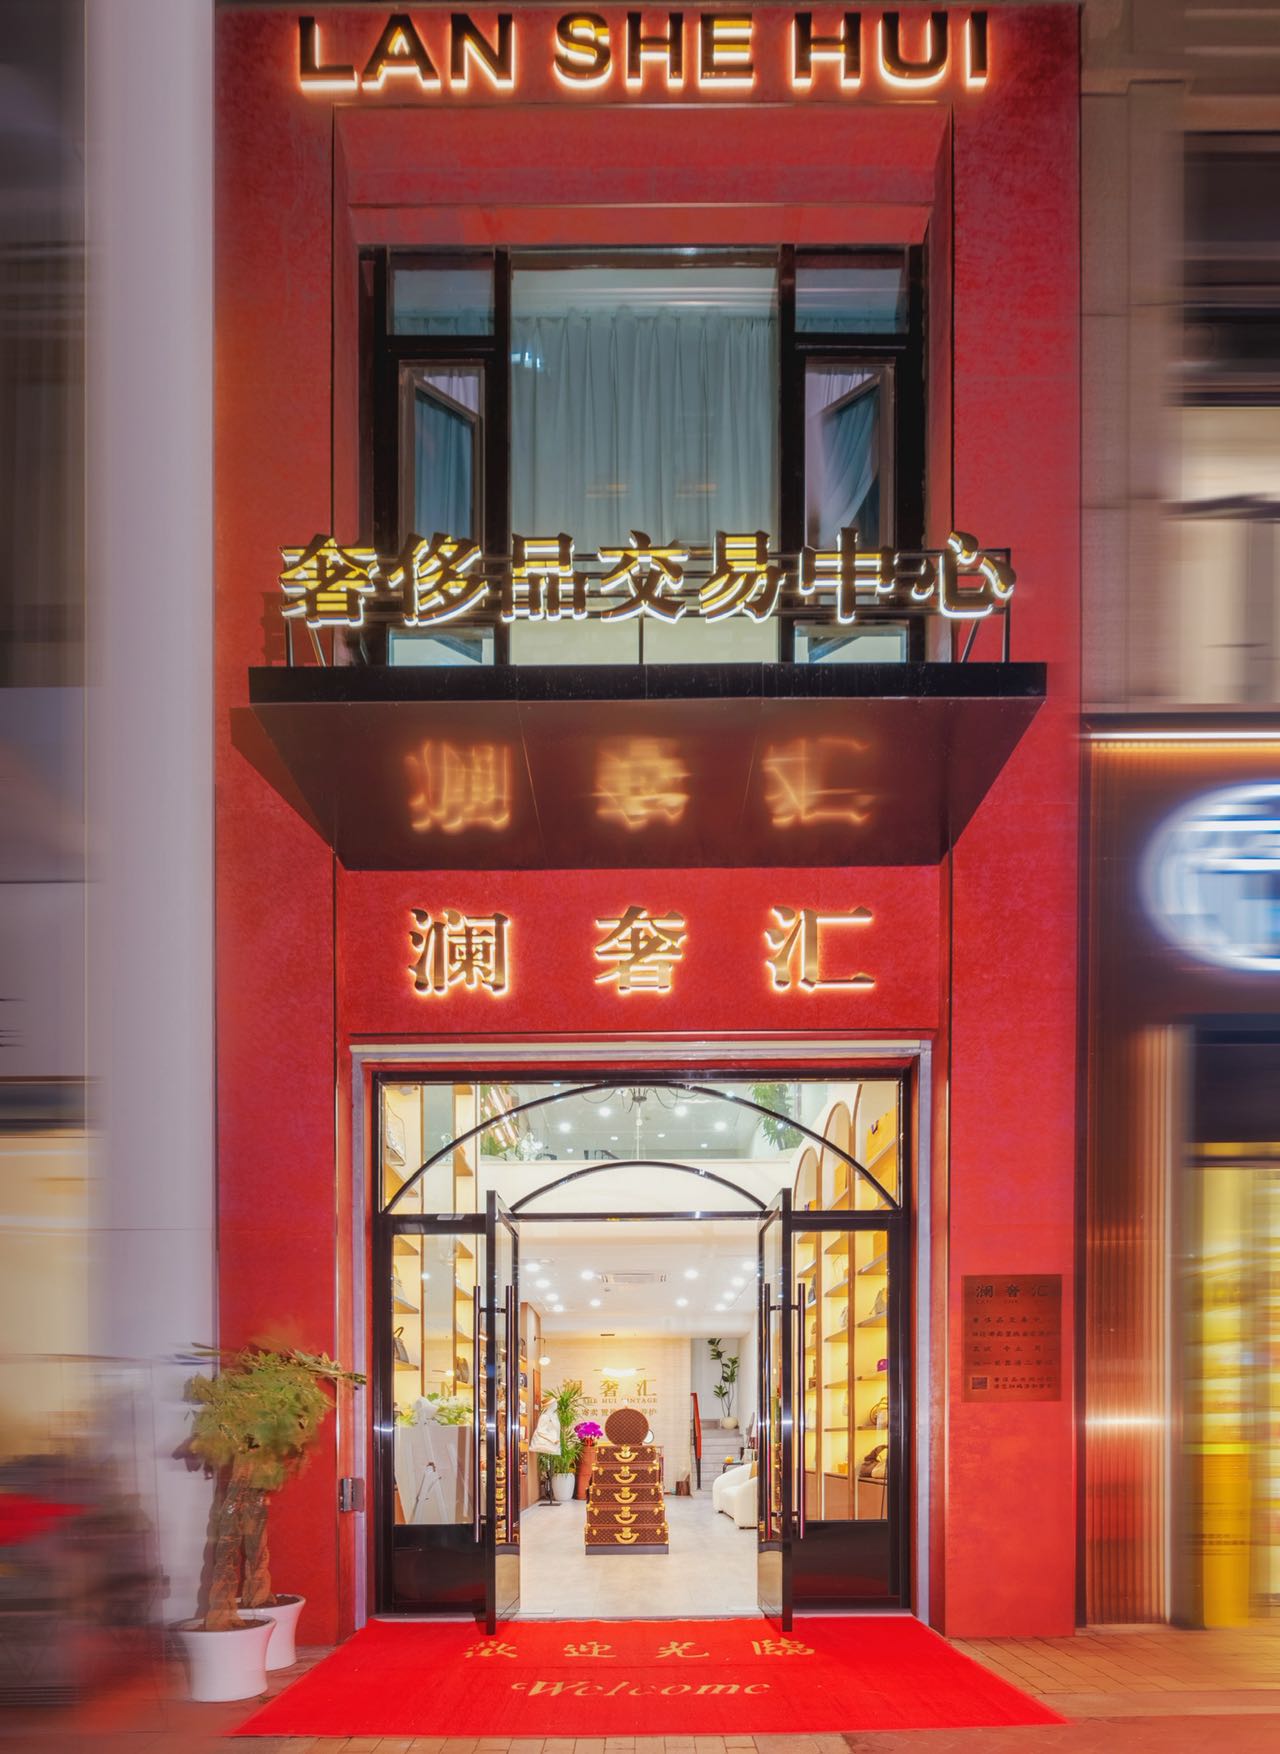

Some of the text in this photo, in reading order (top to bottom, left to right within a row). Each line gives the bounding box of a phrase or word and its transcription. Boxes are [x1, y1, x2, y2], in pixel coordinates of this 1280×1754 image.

[299, 11, 988, 89] LAN SHE HUI
[279, 527, 1015, 627] 奢侈品交易中心
[408, 905, 876, 995] 澜奢汇
[511, 1680, 771, 1697] Welcome
